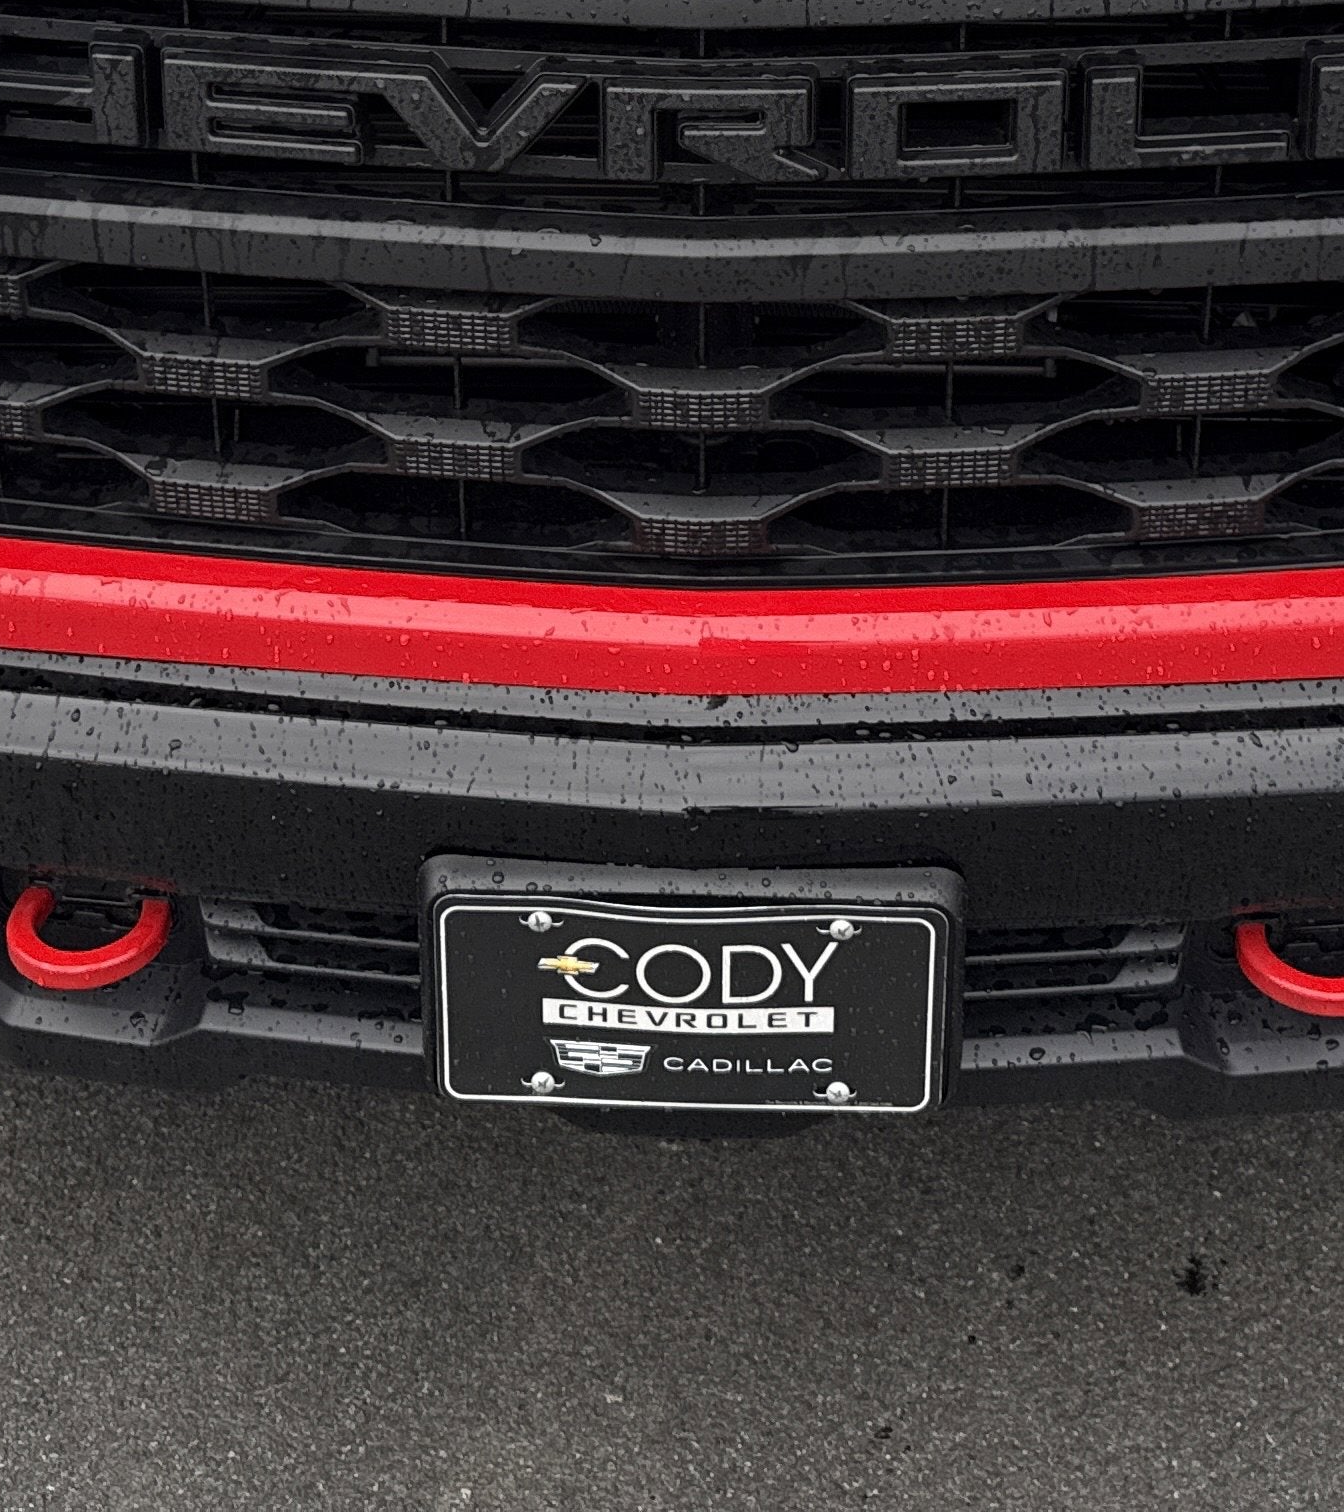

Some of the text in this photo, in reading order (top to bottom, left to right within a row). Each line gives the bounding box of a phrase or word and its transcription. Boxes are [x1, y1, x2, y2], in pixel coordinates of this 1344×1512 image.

[562, 936, 839, 1005] CODY
[557, 1003, 820, 1029] CHEVROLET
[662, 1056, 834, 1074] CADILLAC
